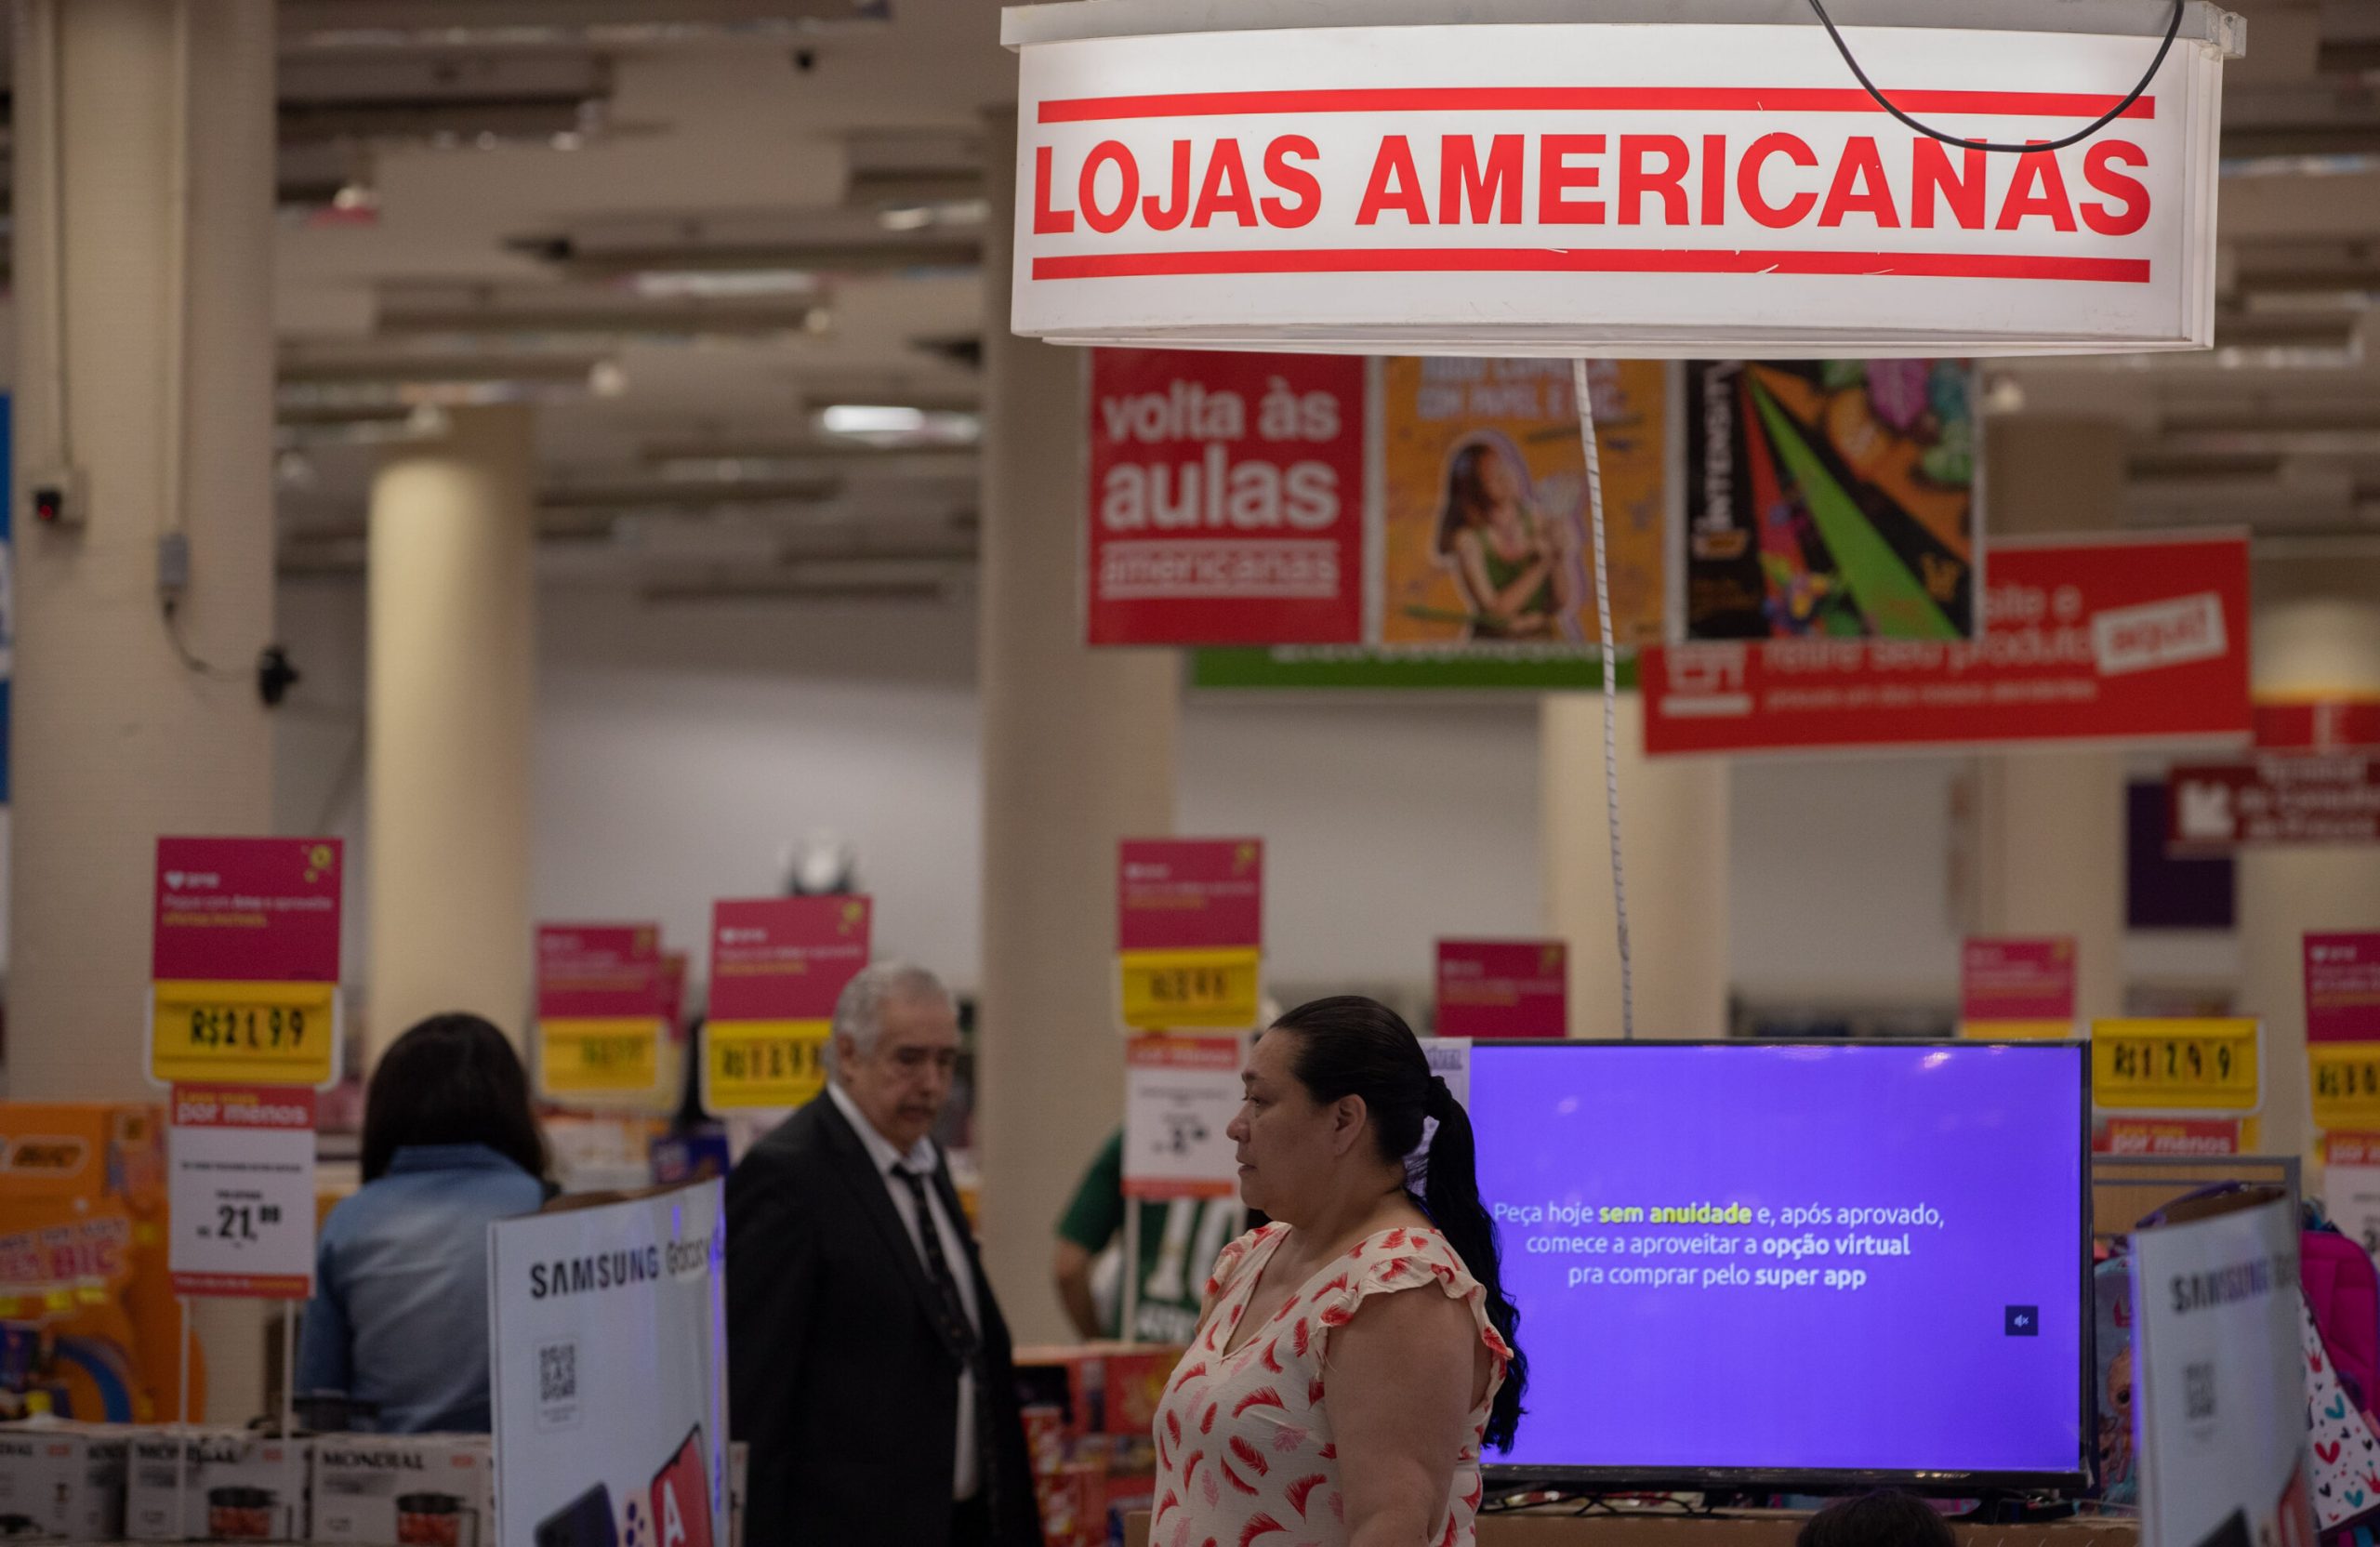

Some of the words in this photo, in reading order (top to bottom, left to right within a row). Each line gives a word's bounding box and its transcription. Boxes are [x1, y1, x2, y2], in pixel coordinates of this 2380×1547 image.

[1034, 135, 1321, 233] LOJAS
[1356, 133, 2150, 235] AMERICANAS
[1101, 378, 1246, 444] volta
[1257, 377, 1342, 443] às
[1101, 443, 1341, 533] aulas
[1098, 552, 1337, 584] americanas
[222, 1104, 308, 1124] menos
[1495, 1203, 1542, 1228] Peça
[1548, 1201, 1593, 1228] hoje
[1598, 1206, 1644, 1223] sem
[1649, 1201, 1752, 1224] anuidade
[1757, 1207, 1777, 1228] e,
[1780, 1202, 1833, 1230] após
[1837, 1203, 1945, 1230] aprovado,
[1526, 1236, 1608, 1254] comece
[1612, 1237, 1626, 1254] a
[1630, 1233, 1740, 1258] aproveitar
[1744, 1237, 1757, 1255] a
[1762, 1234, 1830, 1262] opção
[1834, 1233, 1911, 1256] virtual
[530, 1246, 659, 1301] SAMSUNG
[1568, 1267, 1605, 1289] pra
[1608, 1267, 1698, 1289] comprar
[1701, 1263, 1750, 1287] pelo
[1753, 1268, 1819, 1290] super
[1824, 1269, 1868, 1290] app
[323, 1449, 424, 1470] MONDIAL
